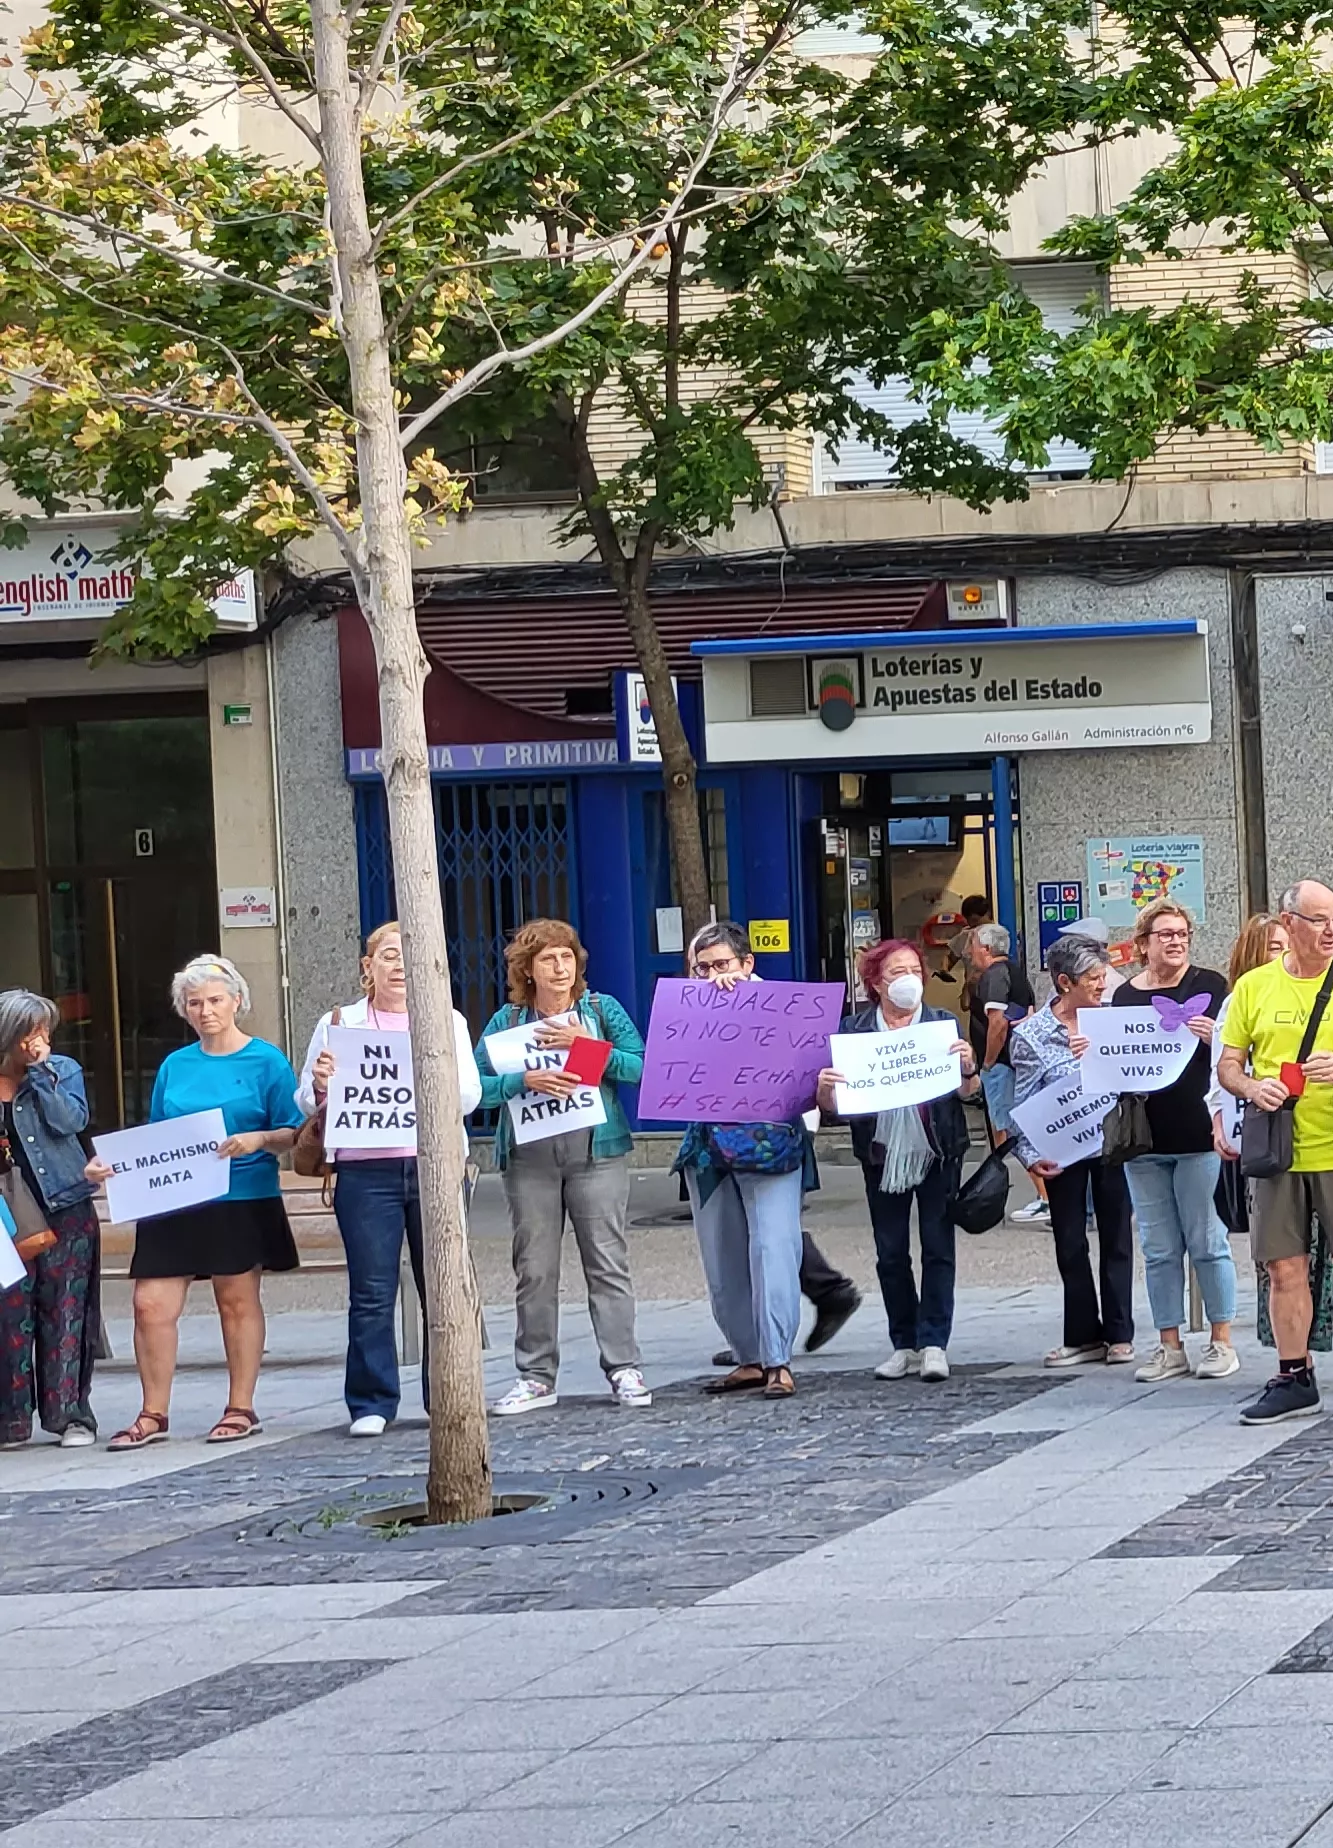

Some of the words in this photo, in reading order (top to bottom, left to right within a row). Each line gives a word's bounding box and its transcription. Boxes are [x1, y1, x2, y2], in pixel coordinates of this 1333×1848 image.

[79, 570, 135, 600] math
[871, 653, 962, 678] Loterías
[970, 657, 983, 678] y
[873, 684, 976, 712] Apuestas
[984, 679, 1018, 702] del
[1026, 676, 1103, 700] Estado
[984, 731, 1028, 744] Alfonso
[1084, 725, 1170, 739] Administración
[472, 746, 485, 767] Y
[505, 740, 618, 766] PRIMITIVA
[138, 831, 151, 854] 6
[754, 934, 781, 947] 106
[681, 985, 827, 1019] RUBIALES
[665, 1020, 689, 1040] SI
[699, 1022, 741, 1042] NO
[749, 1026, 776, 1046] TE
[789, 1033, 828, 1049] VAS
[1124, 1022, 1156, 1034] NOS
[363, 1044, 391, 1059] NI
[875, 1039, 916, 1056] VIVAS
[1099, 1043, 1182, 1056] QUEREMOS
[360, 1063, 398, 1081] UN
[524, 1053, 562, 1071] UN
[868, 1062, 877, 1072] Y
[881, 1053, 927, 1071] LIBRES
[1120, 1065, 1164, 1077] VIVAS
[660, 1061, 708, 1085] TE
[846, 1077, 875, 1090] NOS
[880, 1063, 952, 1086] QUEREMOS
[344, 1086, 412, 1105] PASO
[334, 1106, 416, 1130] ATRÁS
[1046, 1091, 1120, 1134] QUEREMOS
[1072, 1123, 1104, 1144] VIVA
[112, 1161, 132, 1174] EL
[135, 1140, 219, 1169] MACHISMO
[149, 1169, 193, 1189] MATA
